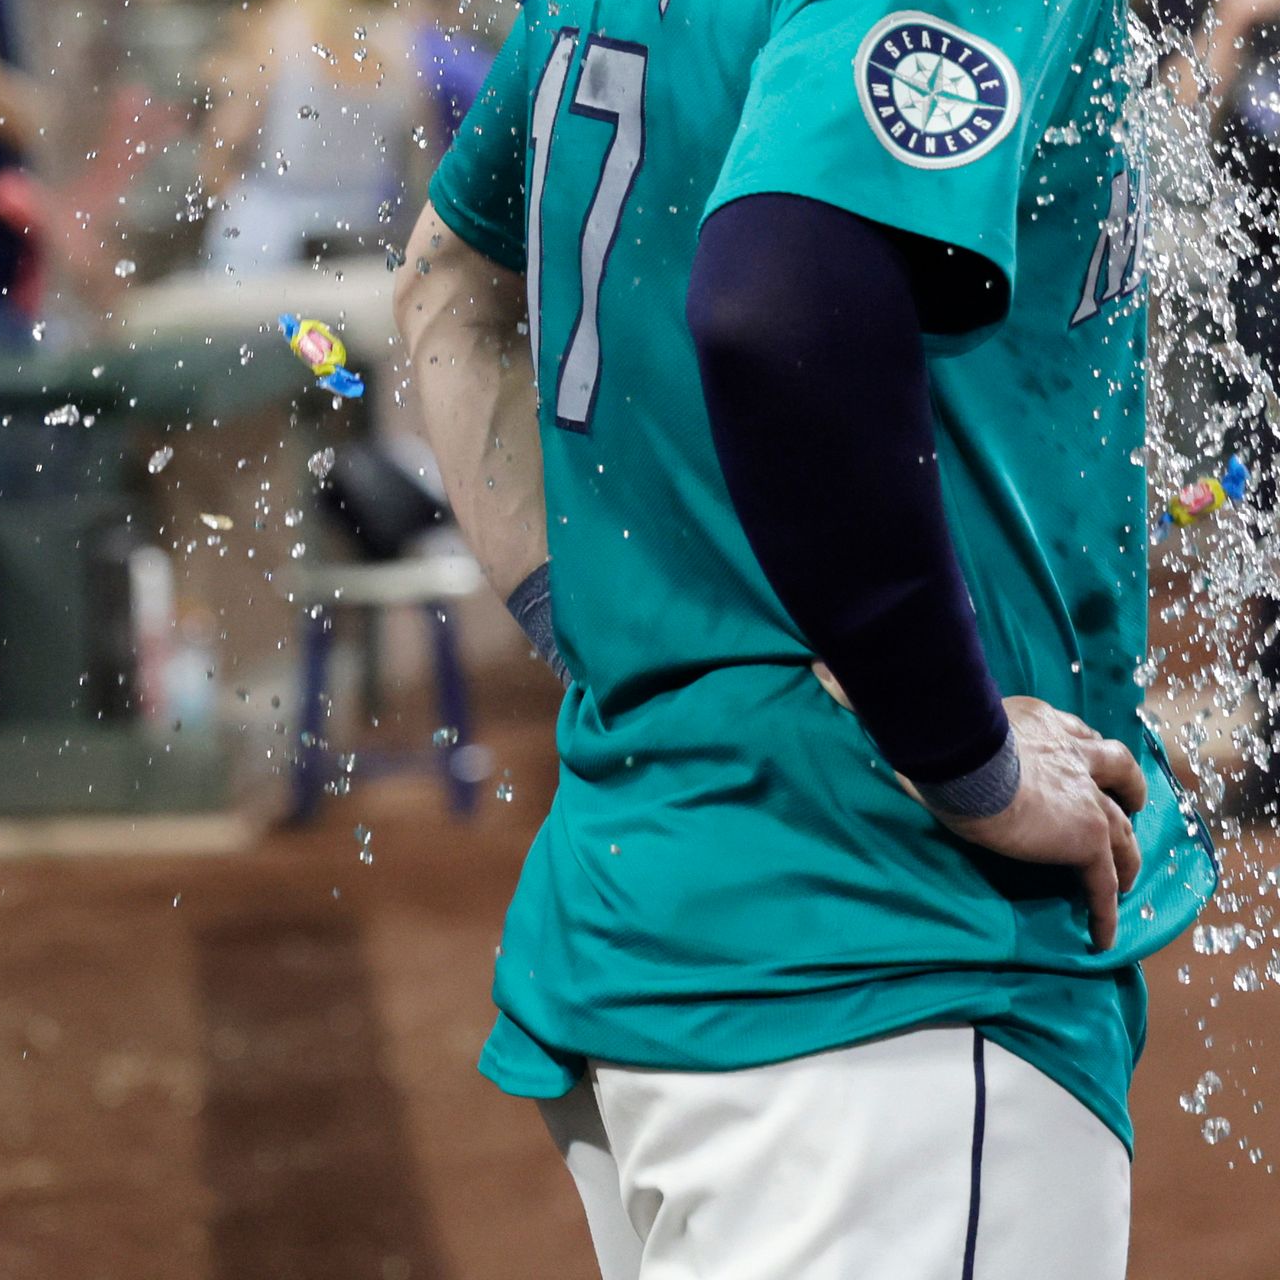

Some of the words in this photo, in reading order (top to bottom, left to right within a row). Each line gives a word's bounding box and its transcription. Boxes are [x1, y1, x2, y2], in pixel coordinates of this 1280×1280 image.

[883, 29, 1000, 90] SEATTLE
[870, 82, 992, 153] MARINERS
[526, 26, 648, 434] 17
